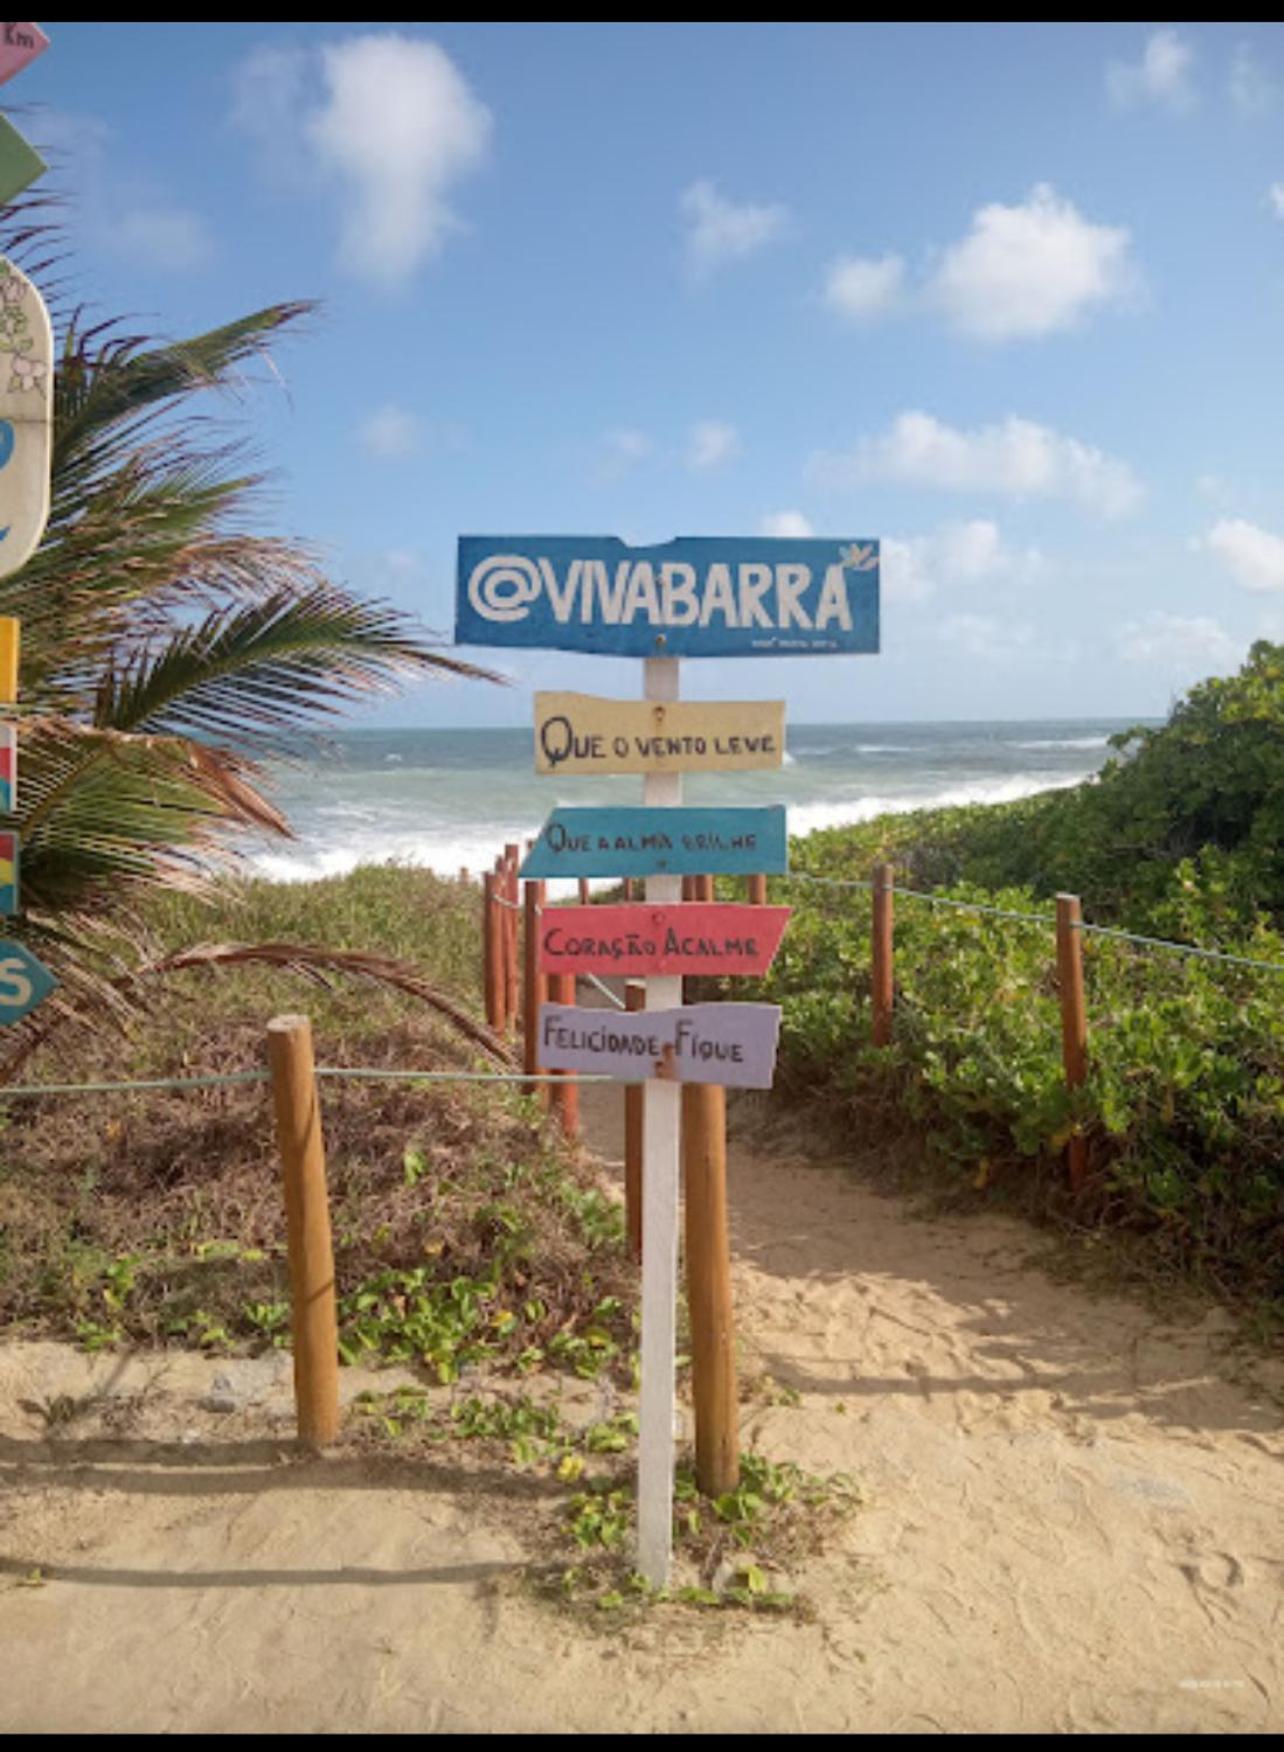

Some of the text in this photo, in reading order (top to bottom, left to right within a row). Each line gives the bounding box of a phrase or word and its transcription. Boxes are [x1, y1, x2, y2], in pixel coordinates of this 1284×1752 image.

[467, 554, 853, 631] @VIVABARRA
[540, 715, 777, 768] QUE O VENTO LEVE
[545, 822, 591, 854] QUE
[614, 832, 673, 852] ALMA
[543, 927, 759, 960] CORAÇÃO ACALME
